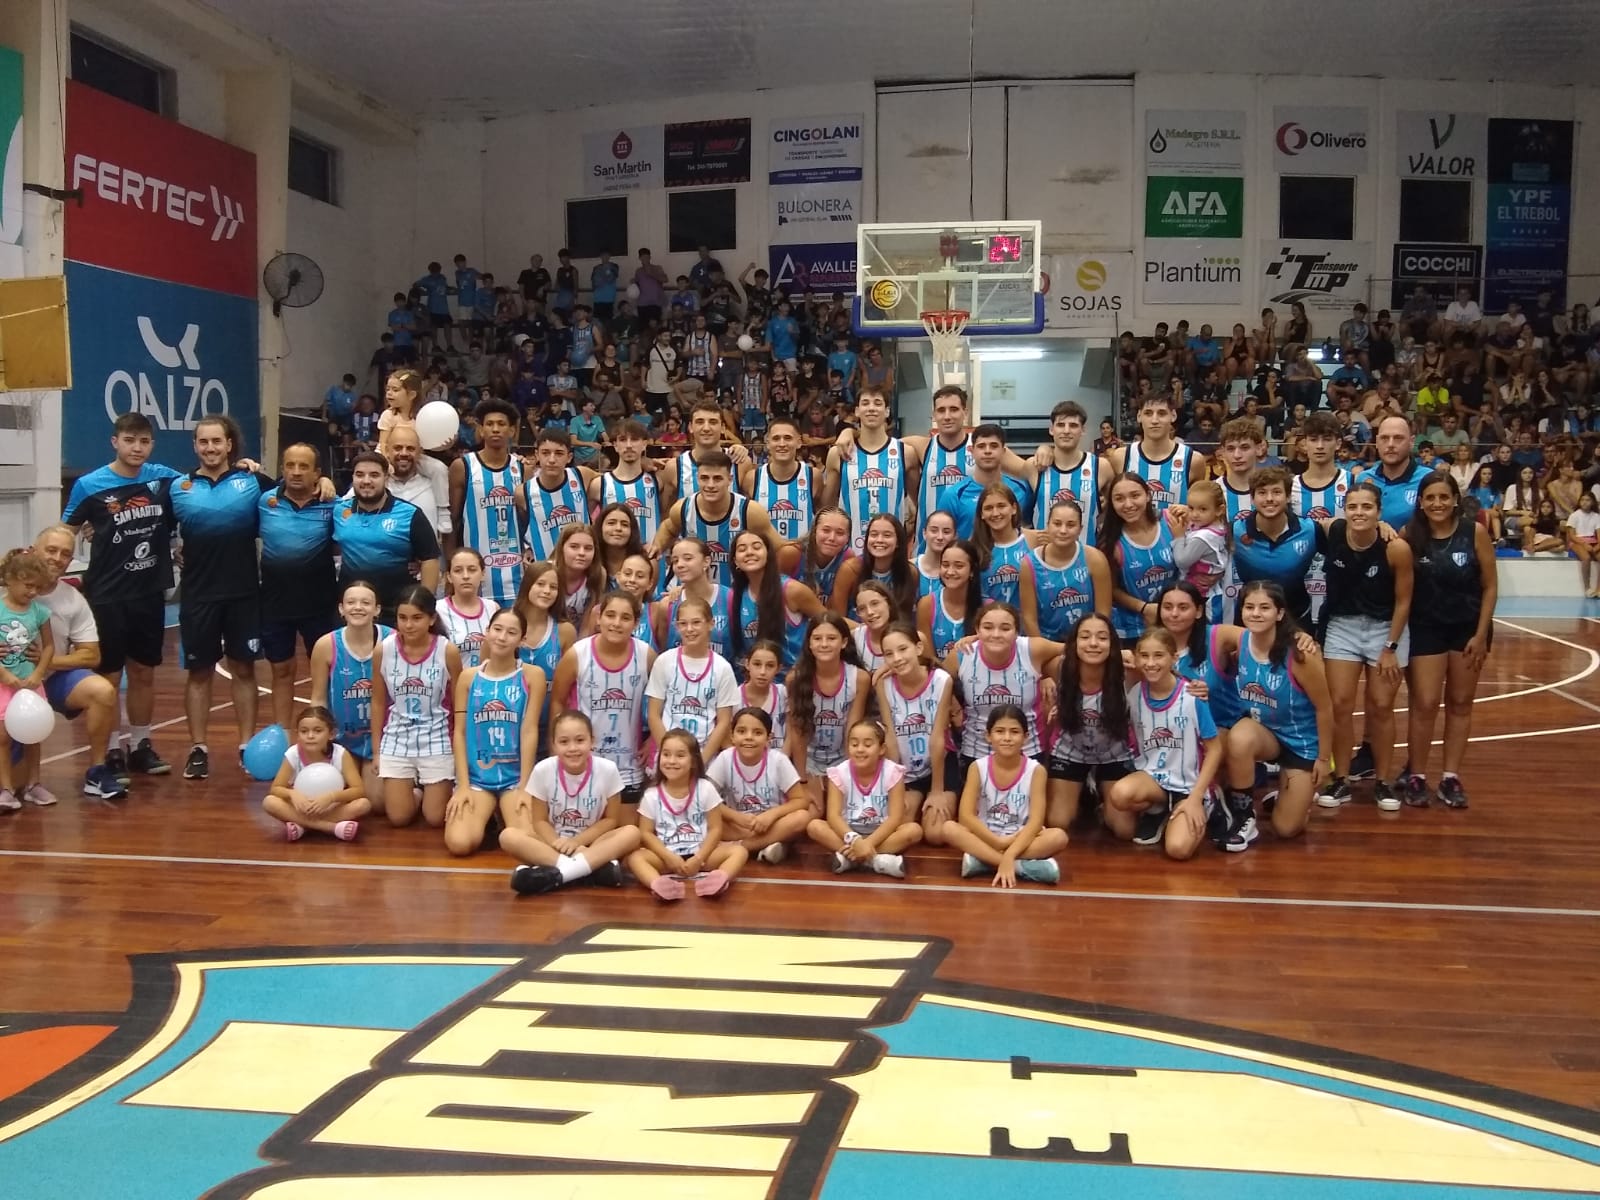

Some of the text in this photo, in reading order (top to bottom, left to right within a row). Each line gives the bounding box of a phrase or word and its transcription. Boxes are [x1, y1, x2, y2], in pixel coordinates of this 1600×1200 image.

[774, 126, 859, 142] CINGOLANI
[1310, 132, 1366, 148] Olivero
[593, 165, 615, 176] San
[1408, 153, 1475, 175] VALOR
[73, 153, 206, 226] FERTEC
[1508, 189, 1552, 203] YPF
[778, 198, 852, 214] BULONERA
[1161, 190, 1228, 215] AFA
[1497, 206, 1560, 221] EL TREBOL
[1144, 258, 1240, 282] Plantium
[1404, 256, 1470, 271] COCCHI
[1060, 296, 1121, 310] SOJAS
[931, 475, 945, 487] SAN
[480, 496, 495, 509] SAN
[113, 504, 163, 526] SAN MARTIN
[495, 508, 508, 522] 10
[542, 518, 558, 531] SAN
[779, 522, 787, 536] 9
[710, 564, 718, 579] 7
[988, 576, 1001, 587] SAN
[1136, 577, 1149, 588] SAN
[1002, 586, 1010, 602] 4
[1050, 595, 1089, 609] SAN MARTIN
[343, 689, 357, 699] SAN
[973, 695, 1022, 706] SAN MARTIN
[1250, 691, 1278, 709] MARTIN
[405, 698, 421, 715] 12
[591, 700, 607, 710] SAN
[474, 710, 518, 723] SAN MARTIN
[608, 713, 618, 731] 7
[680, 719, 698, 735] 10
[488, 727, 505, 746] 14
[909, 737, 925, 755] 10
[1158, 752, 1167, 768] 6
